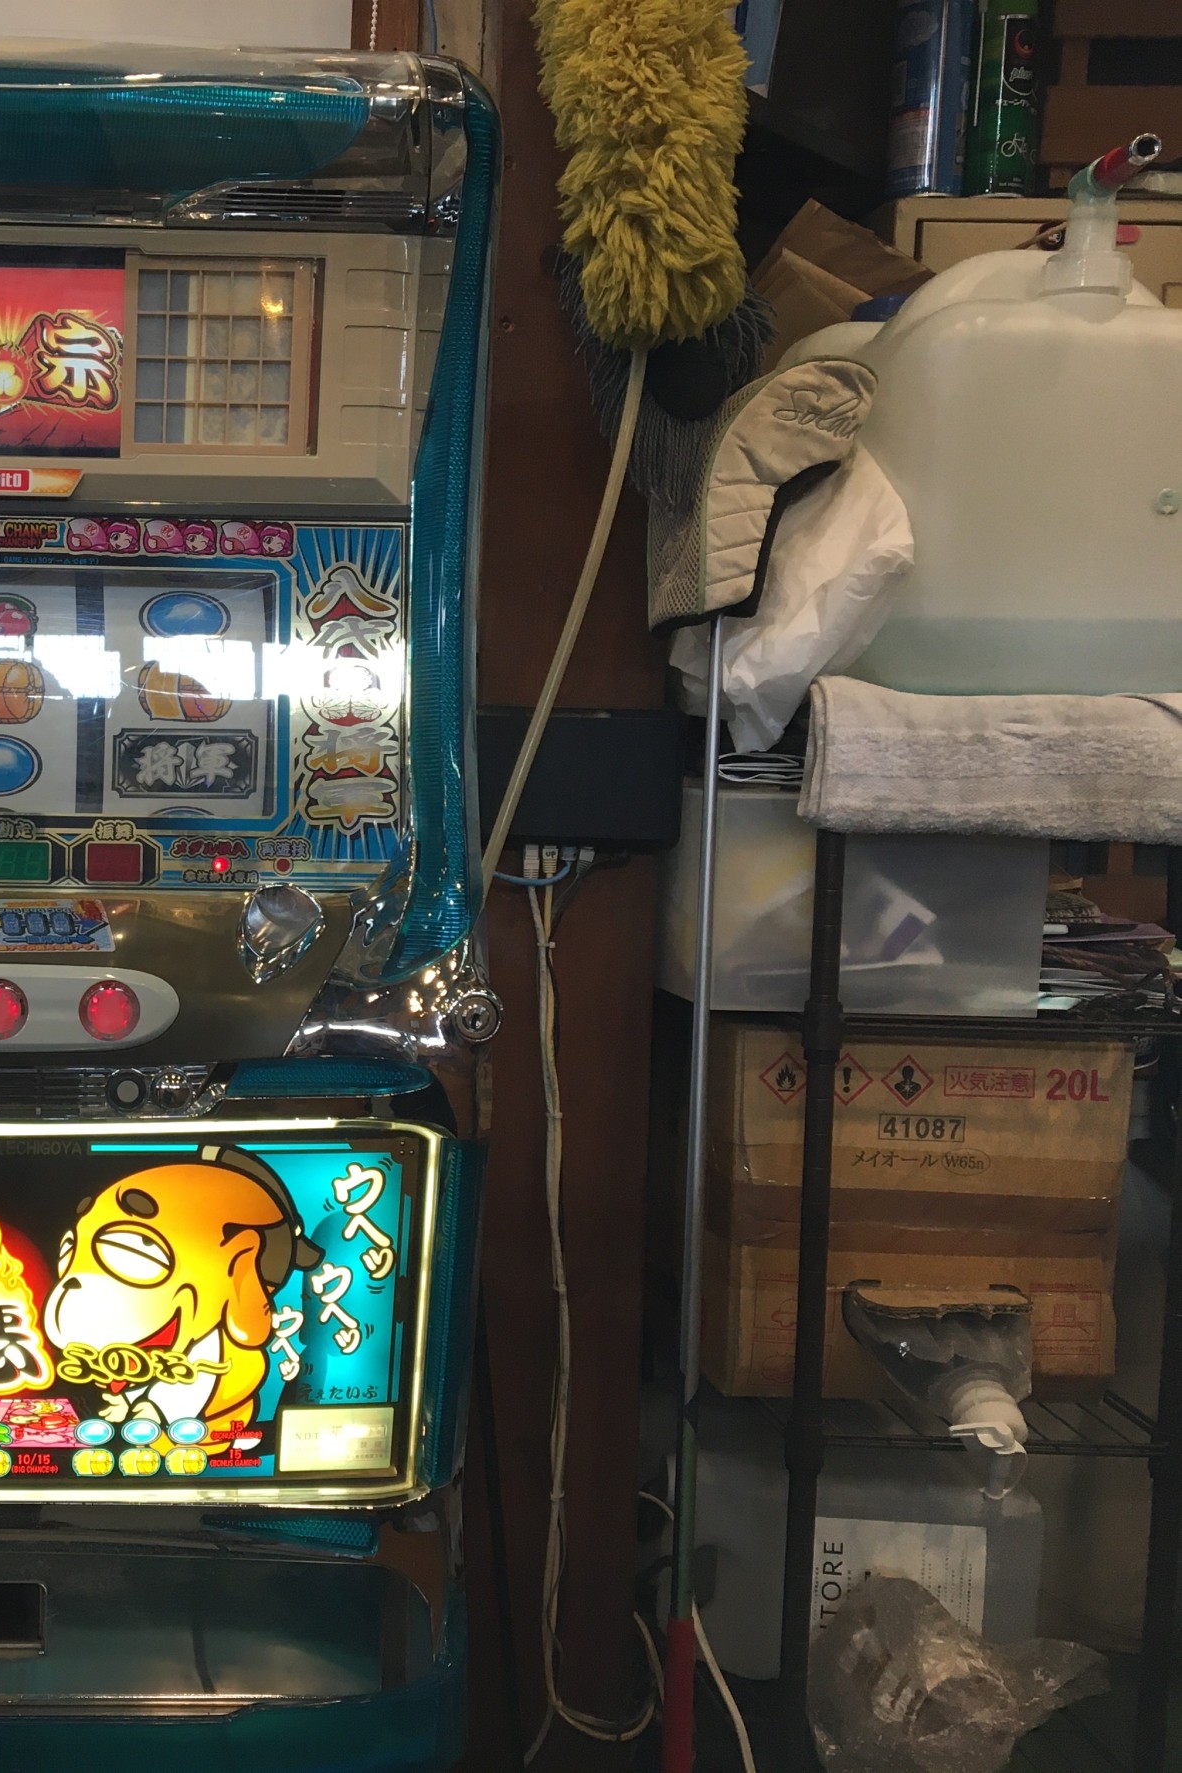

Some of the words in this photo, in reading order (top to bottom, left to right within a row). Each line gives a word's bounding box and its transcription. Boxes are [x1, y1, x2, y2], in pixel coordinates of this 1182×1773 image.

[5, 522, 57, 539] CHANCE
[136, 741, 237, 788] 将軍
[96, 822, 135, 842] 振舞
[261, 841, 308, 858] 再遊技
[949, 1072, 1031, 1093] 火気注意
[1046, 1068, 1110, 1102] 20L
[883, 1116, 962, 1140] 41087
[851, 1150, 939, 1169] メイオール
[331, 1161, 396, 1280] ウヘッ
[310, 1261, 362, 1355] ウヘッ
[270, 1304, 305, 1383] ウヘッ
[231, 1421, 244, 1432] 15
[17, 1453, 51, 1465] 10/15
[229, 1448, 242, 1459] 15
[819, 1541, 844, 1629] TORE
